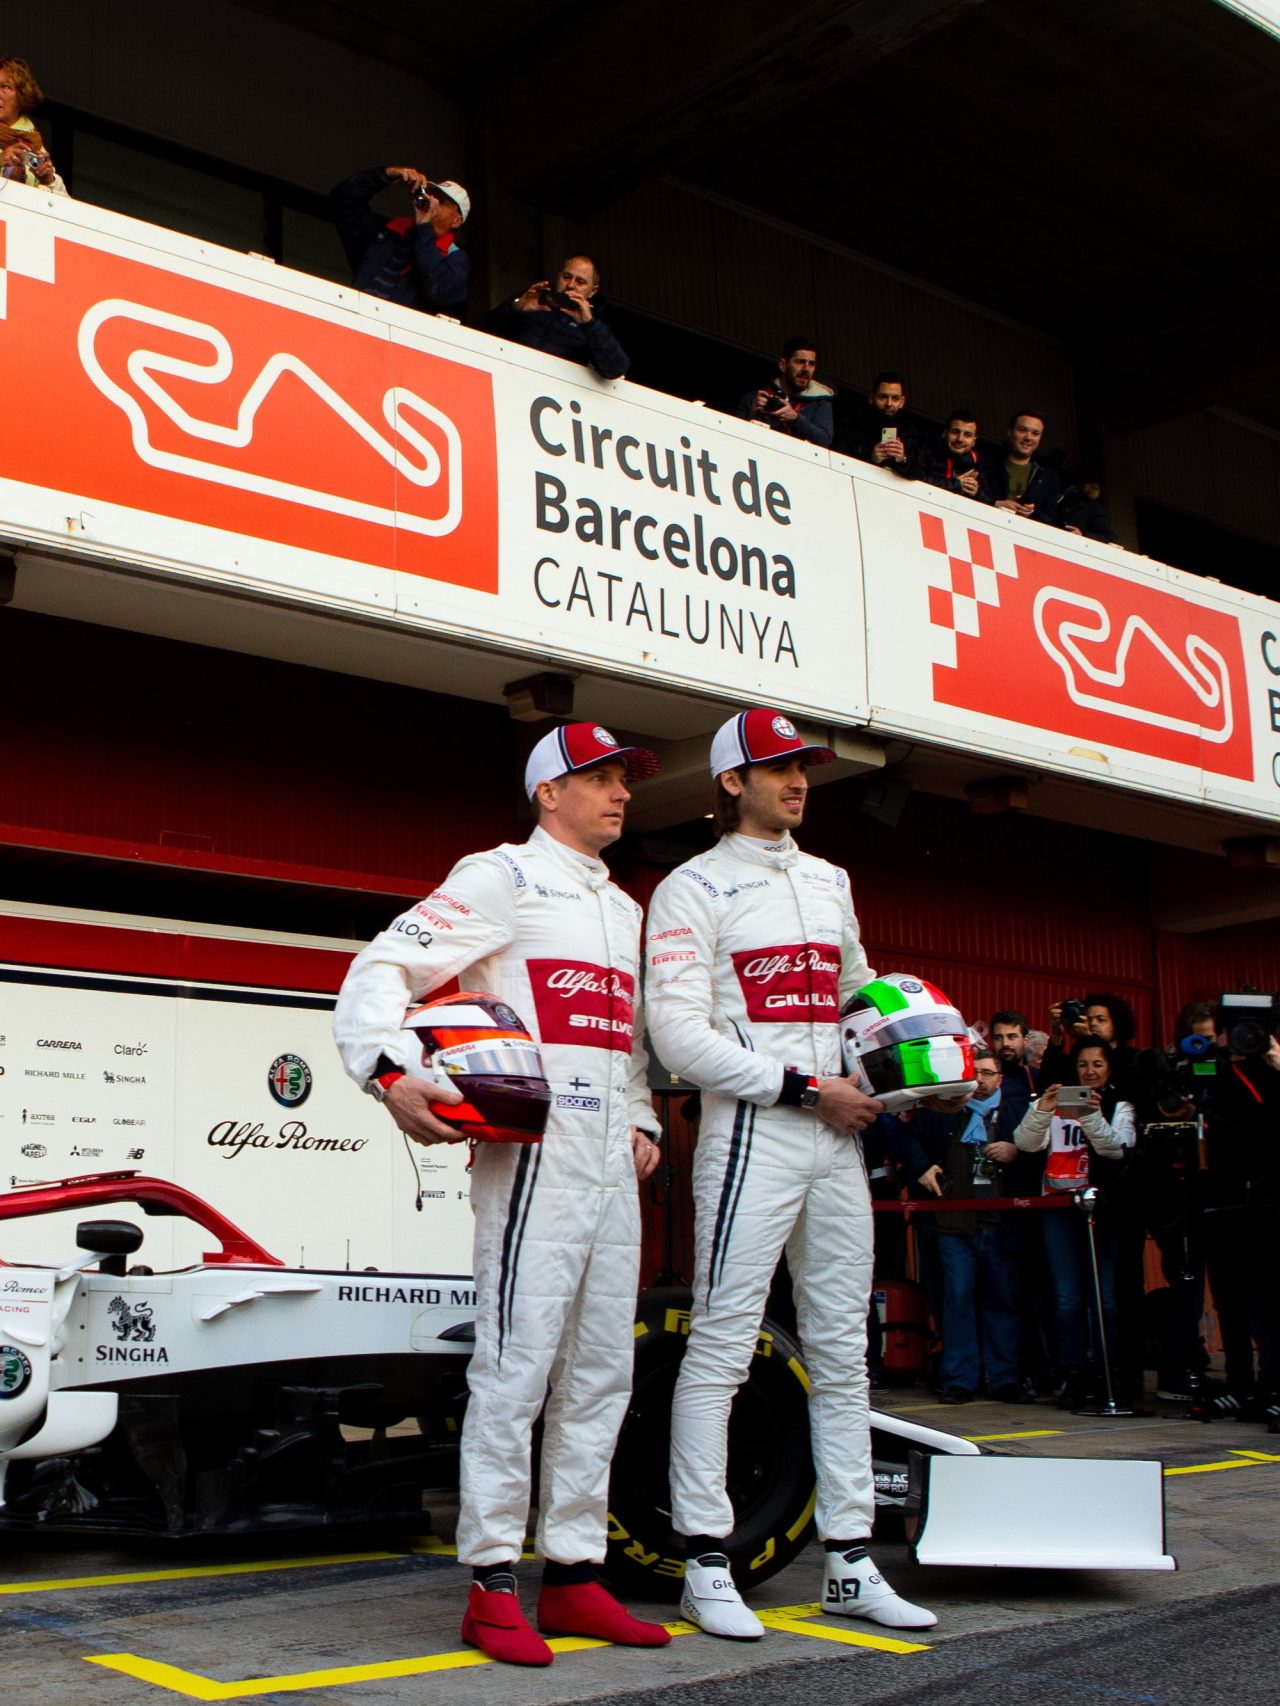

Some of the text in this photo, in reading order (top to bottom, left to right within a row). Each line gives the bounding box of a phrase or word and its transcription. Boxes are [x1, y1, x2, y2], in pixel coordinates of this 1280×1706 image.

[529, 395, 792, 526] Circuit de
[534, 470, 796, 600] Barcelona
[533, 556, 799, 668] CATALUNYA
[549, 889, 582, 900] SINGHA
[739, 880, 770, 891] SINGHA
[431, 891, 471, 917] CARRERA
[650, 927, 693, 941] CARRERA
[652, 951, 696, 966] PIRELLI
[743, 954, 794, 985] Alfa
[547, 969, 602, 998] Alfa
[37, 1039, 82, 1050] CARRERA
[114, 1044, 143, 1056] Claro
[24, 1069, 86, 1080] RICHARD MILLE
[116, 1075, 146, 1084] SINGHA
[557, 1095, 600, 1110] sparco
[207, 1121, 369, 1159] Alfa Romeo
[2, 1280, 48, 1294] Romeo
[338, 1286, 441, 1305] RICHARD
[95, 1345, 169, 1363] SINGHA
[607, 1511, 688, 1578] ERO
[826, 1577, 861, 1604] 99
